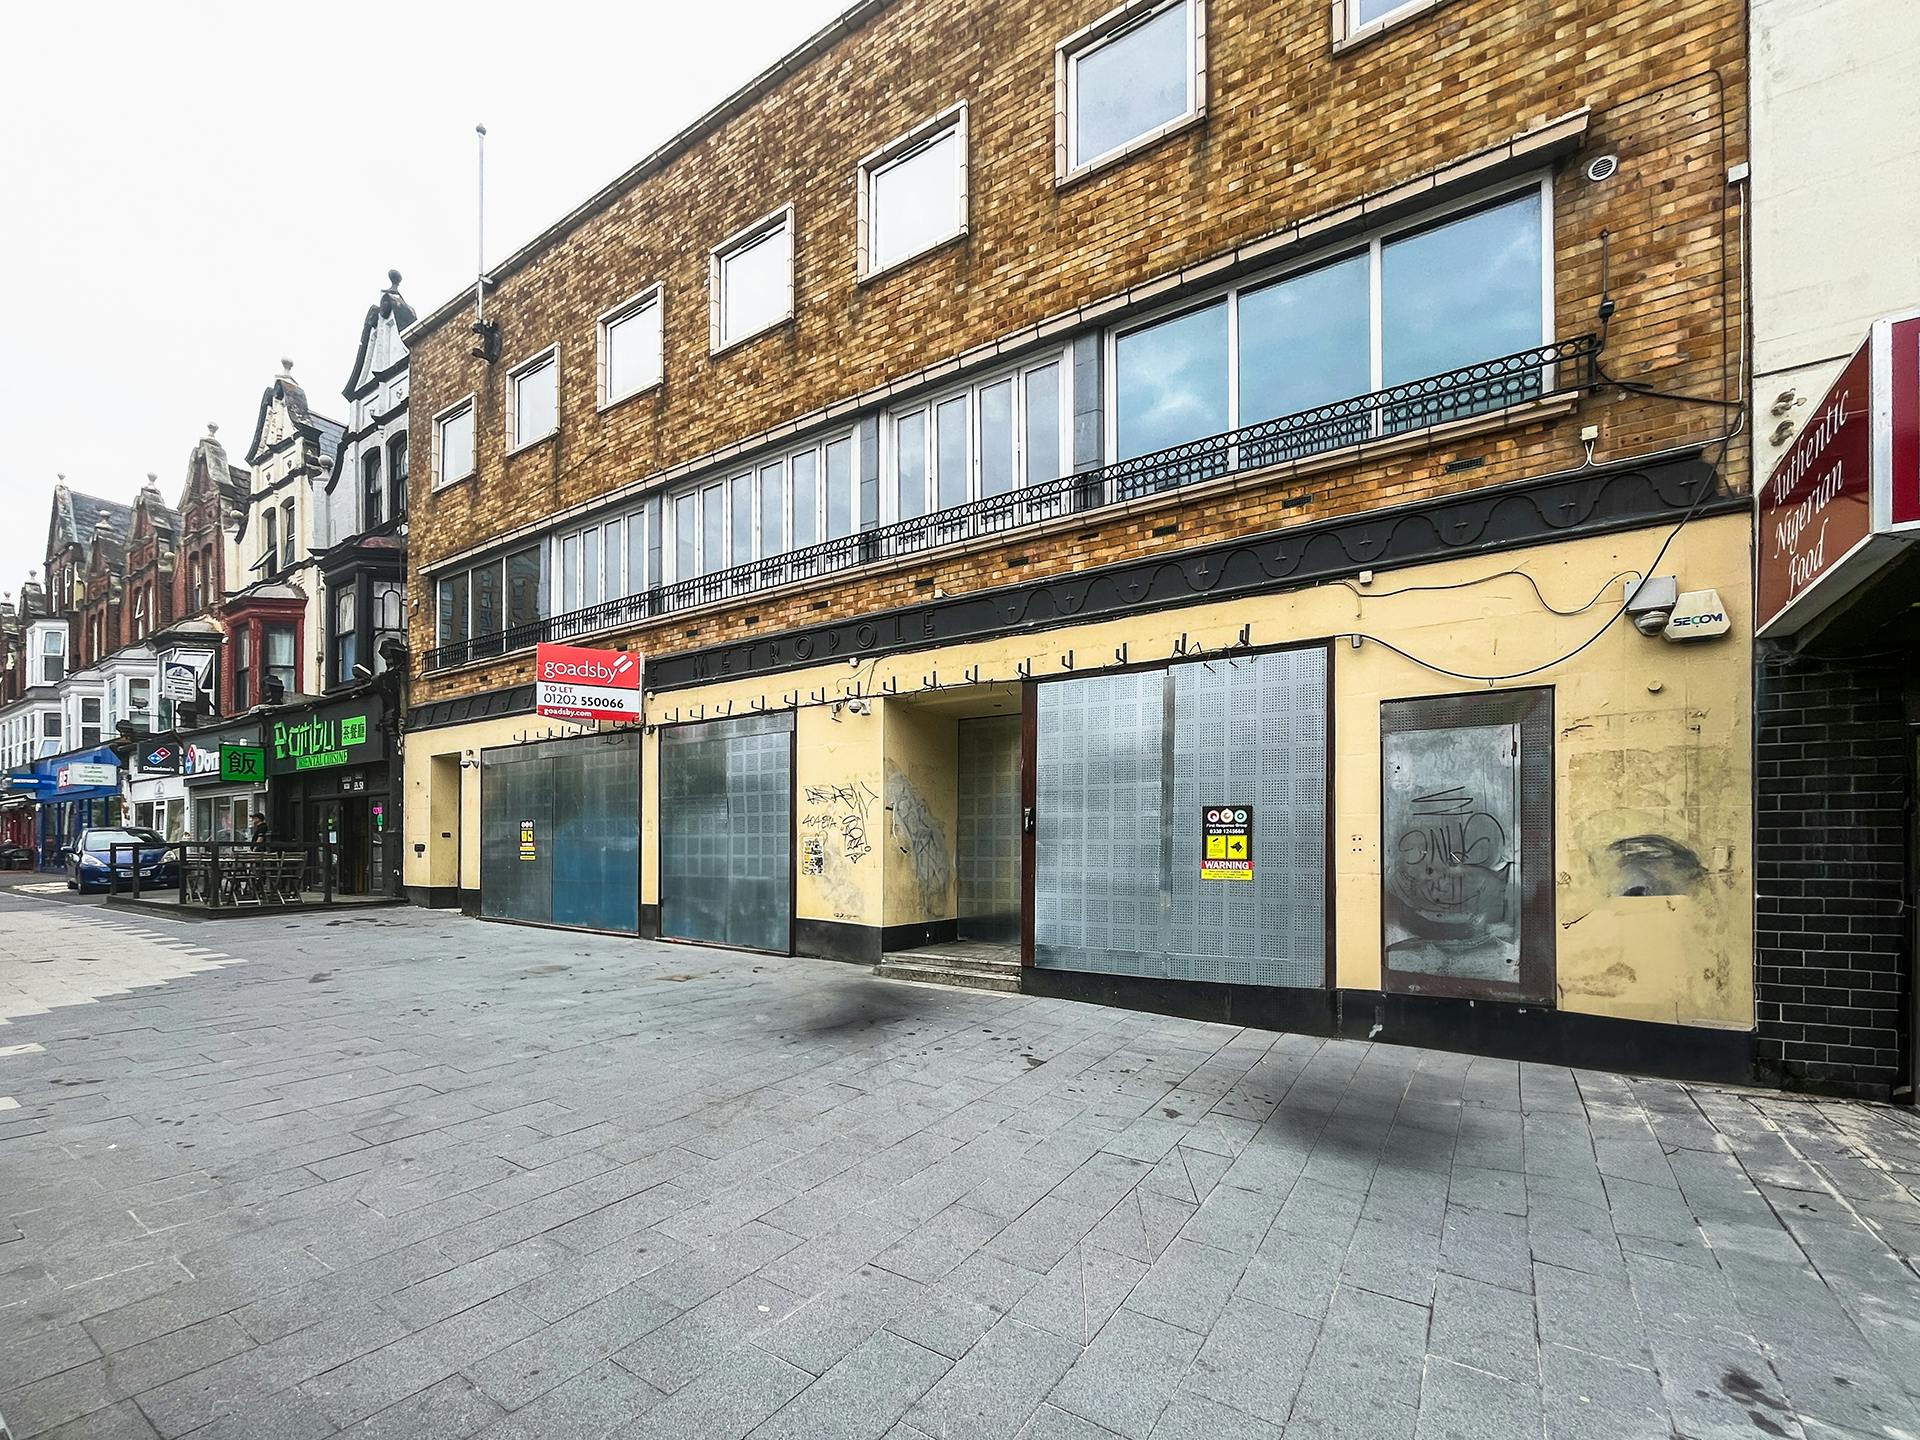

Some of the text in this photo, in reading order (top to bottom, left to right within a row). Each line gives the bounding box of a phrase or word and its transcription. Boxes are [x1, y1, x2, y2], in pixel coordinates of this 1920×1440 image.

[1770, 389, 1849, 515] Authentic
[1773, 459, 1844, 560] Nigerian
[1785, 517, 1829, 606] Food
[1673, 613, 1723, 627] SECOM
[693, 610, 936, 680] METROPOLE
[543, 659, 618, 684] goadsby
[543, 693, 624, 709] 01202 550066
[543, 708, 592, 717] goadsby.com
[227, 750, 257, 775] 飯
[1204, 861, 1249, 869] WARNING
